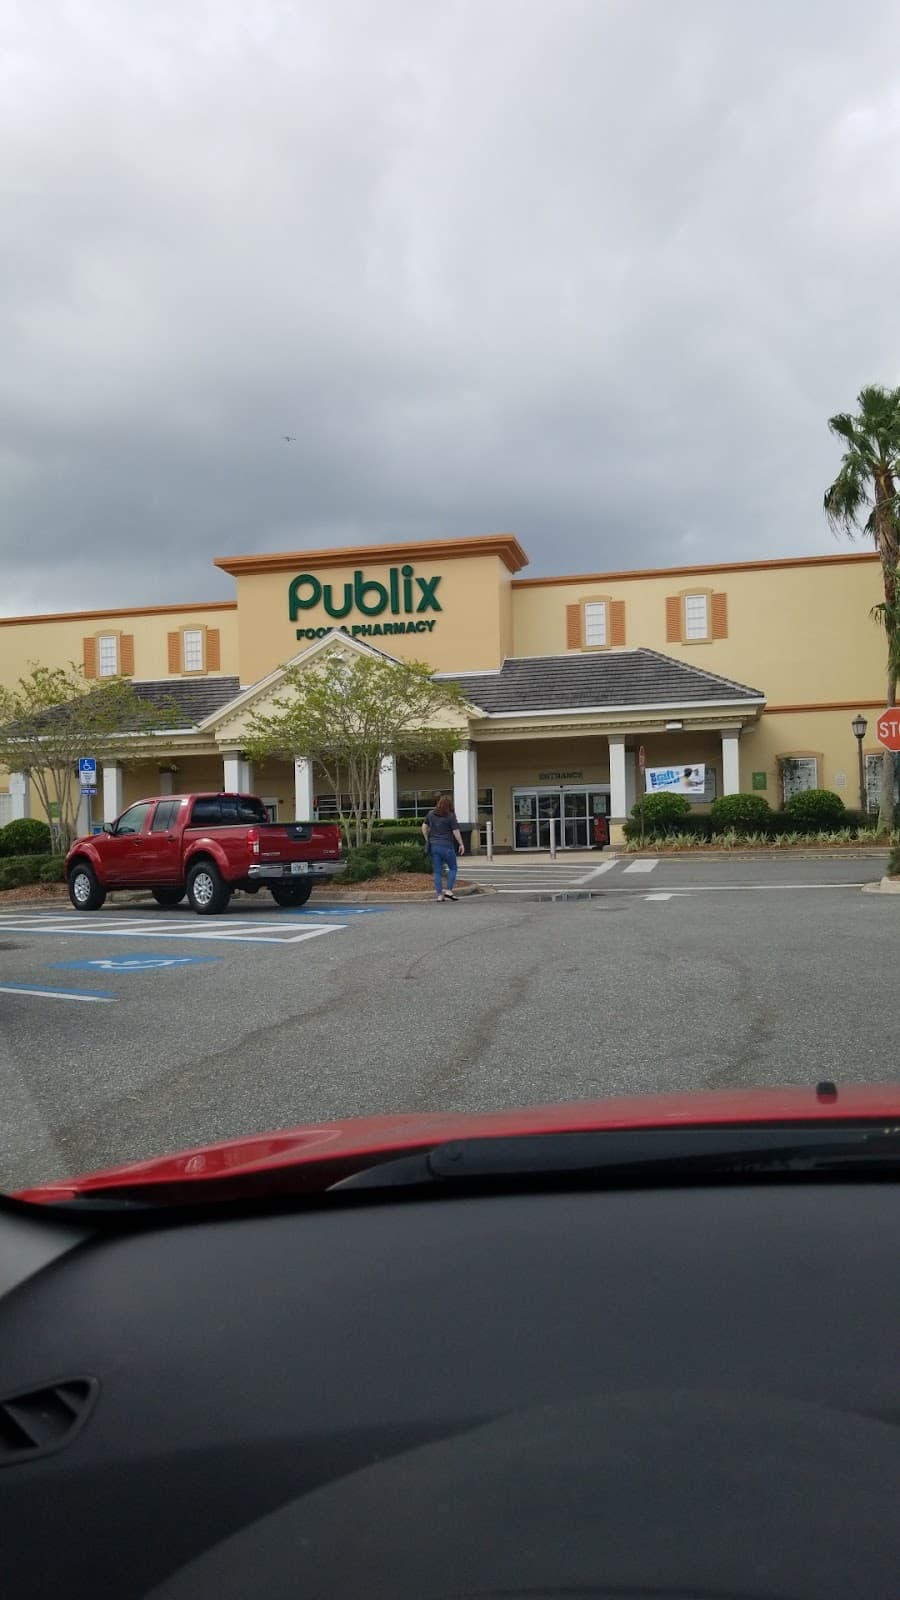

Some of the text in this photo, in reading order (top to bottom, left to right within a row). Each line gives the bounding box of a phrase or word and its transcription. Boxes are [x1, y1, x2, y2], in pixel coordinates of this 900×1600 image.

[288, 565, 443, 622] Publix
[351, 620, 436, 637] PHARMACY
[879, 721, 900, 738] ST
